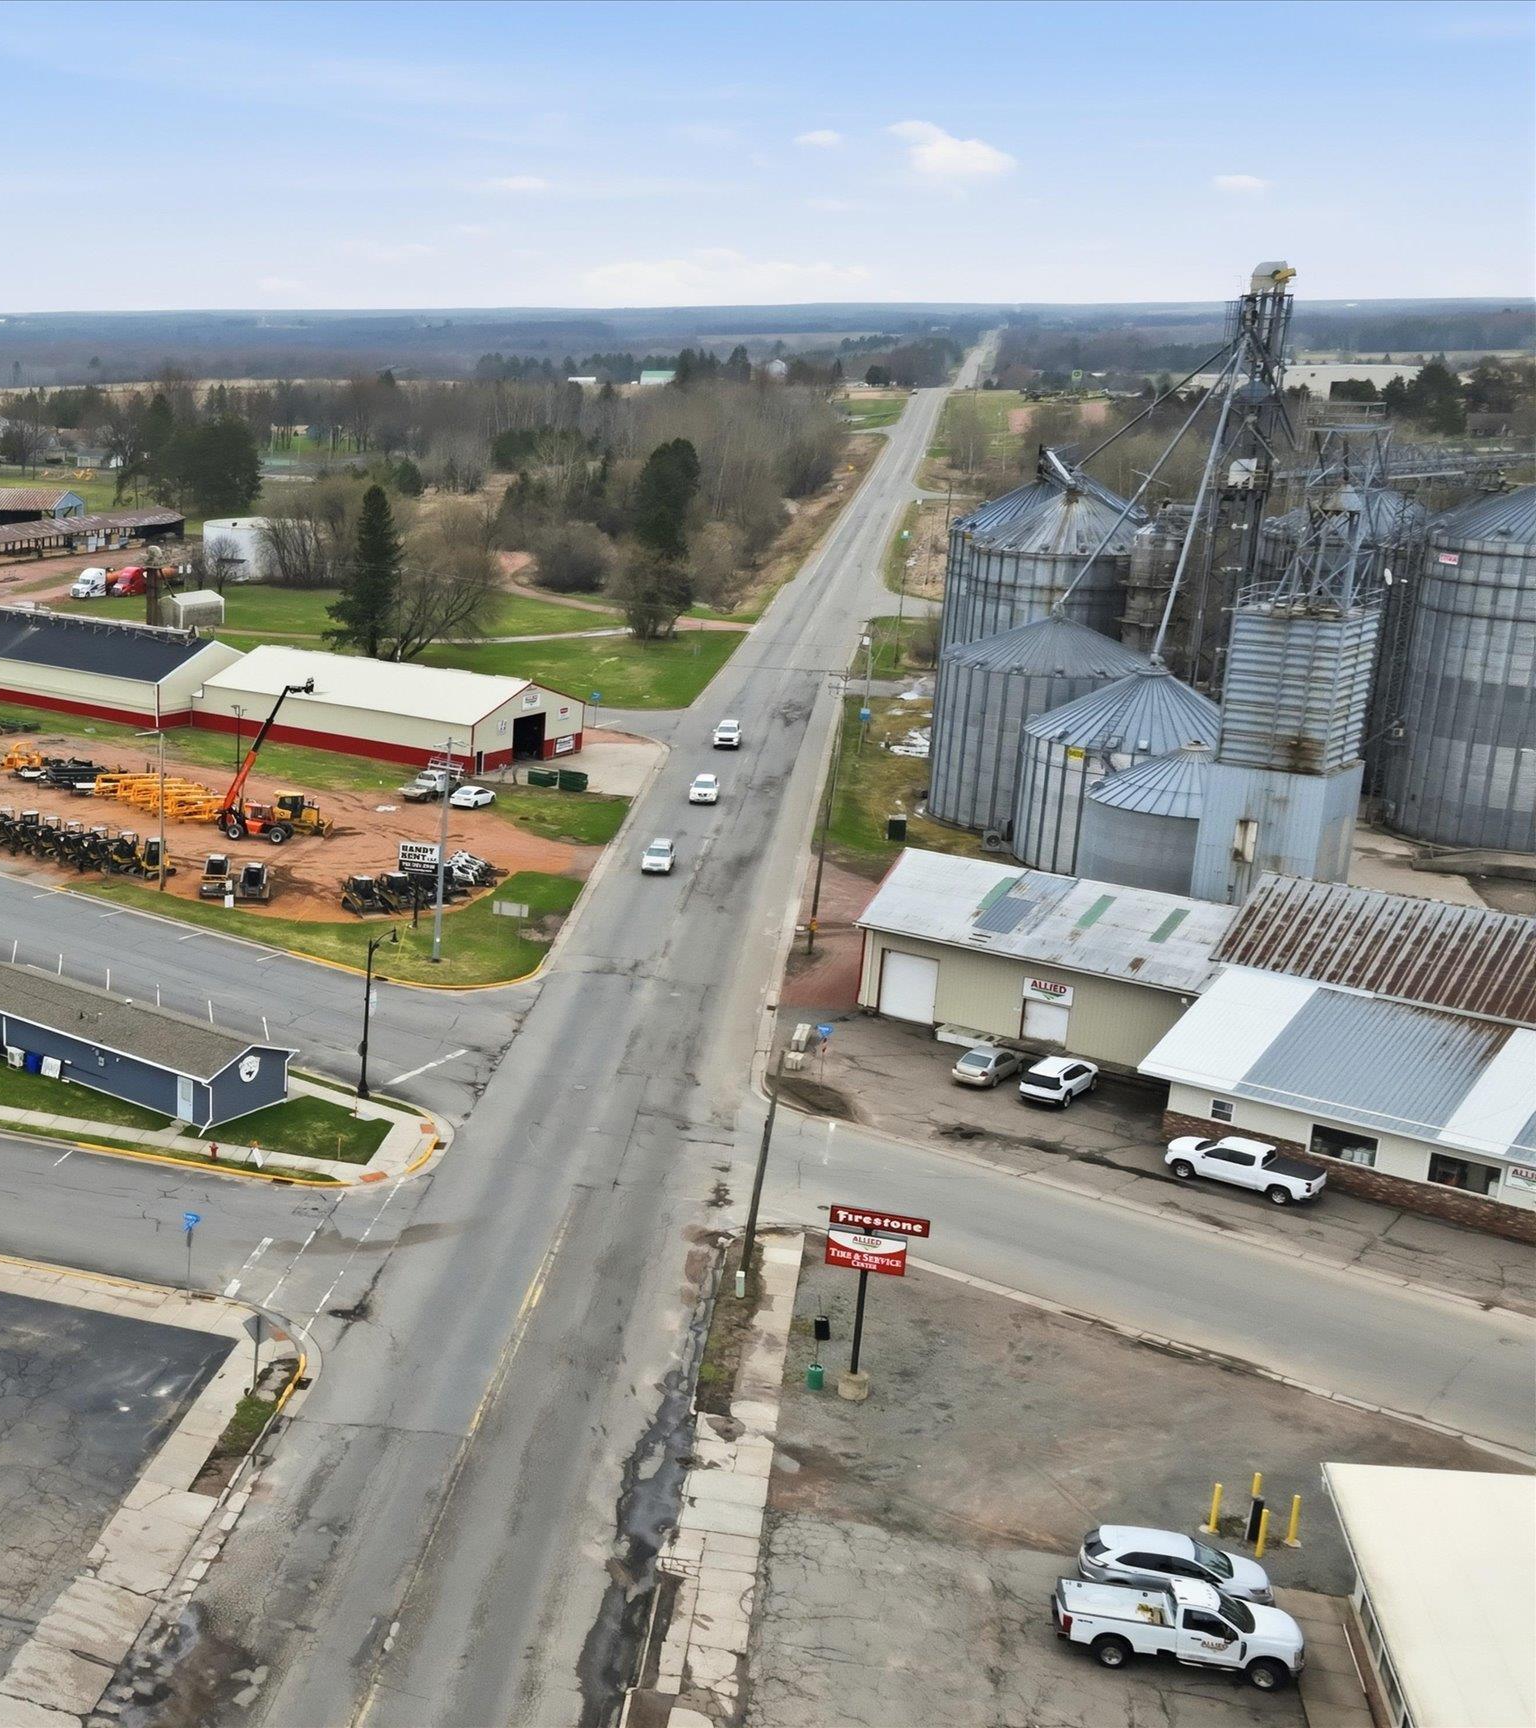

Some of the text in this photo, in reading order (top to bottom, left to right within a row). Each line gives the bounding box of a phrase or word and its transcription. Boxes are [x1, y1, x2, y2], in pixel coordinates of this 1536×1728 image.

[401, 845, 435, 854] HANDY
[1031, 980, 1067, 994] ALLIED
[837, 1210, 923, 1233] Firestone
[853, 1236, 882, 1246] ALLIED
[853, 1251, 861, 1261] &
